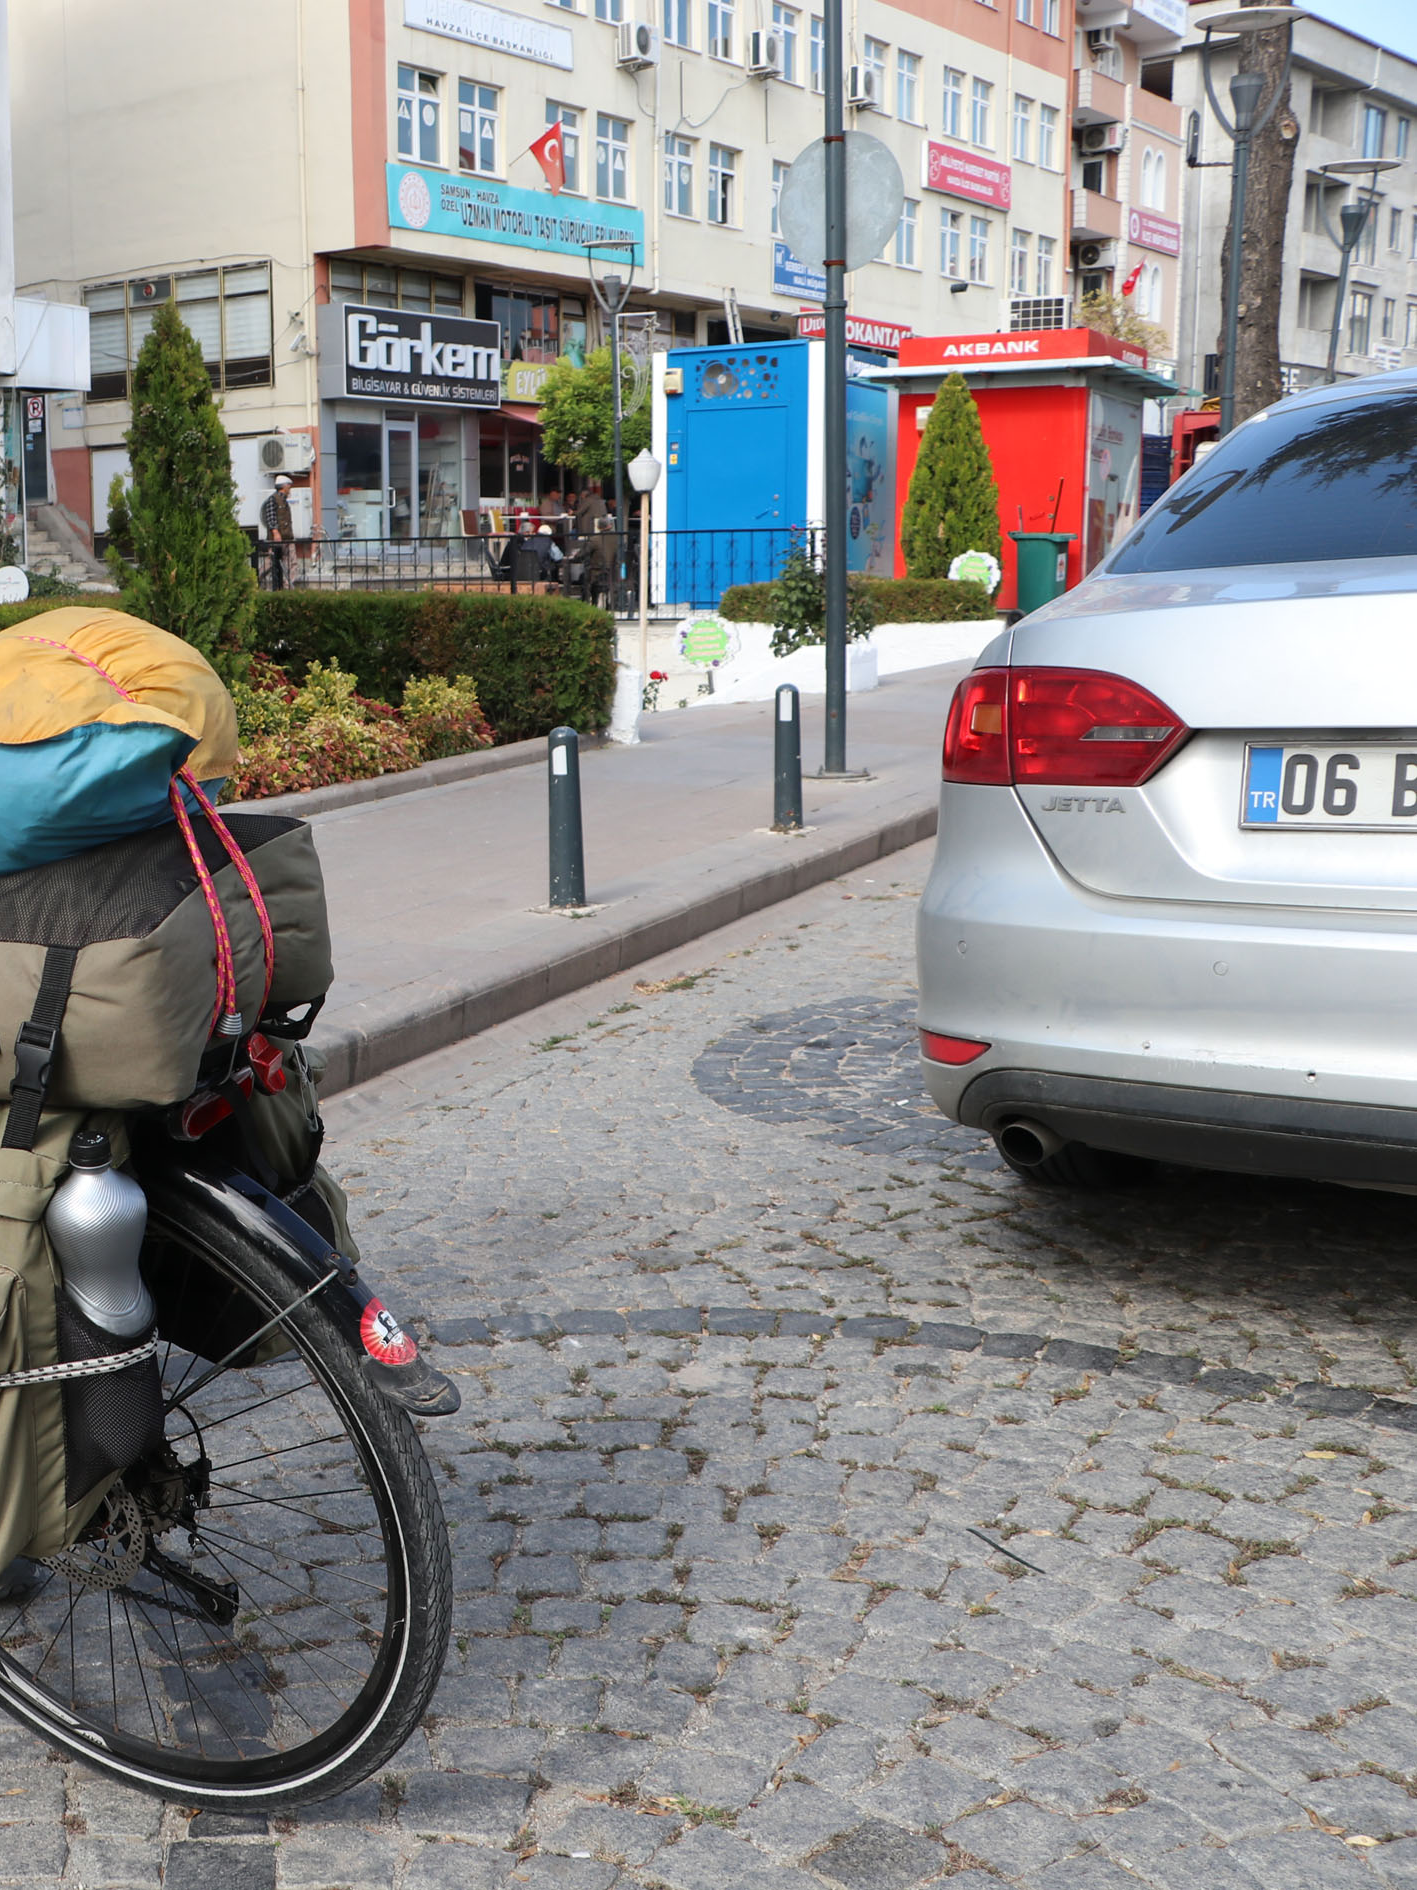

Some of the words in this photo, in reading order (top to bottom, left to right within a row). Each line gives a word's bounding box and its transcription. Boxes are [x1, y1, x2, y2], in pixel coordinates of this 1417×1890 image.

[426, 17, 462, 34] HAVZA
[465, 28, 489, 42] İLÇE
[440, 183, 471, 199] SAMSUN
[477, 190, 500, 204] HAVZA
[461, 202, 491, 229] UZMAN
[494, 207, 533, 236] MOTORLU
[535, 214, 557, 245] TAŞIT
[348, 313, 500, 381] Görkem
[845, 320, 912, 348] OKANTA
[943, 339, 1040, 357] AKBANK
[352, 375, 401, 393] BİLGİSAYAR
[403, 382, 410, 395] &
[411, 380, 451, 397] GÜVENLİK
[452, 384, 497, 401] SİSTEMLERİ
[515, 367, 546, 397] EYLÜ
[1250, 790, 1276, 809] TR
[1282, 753, 1361, 816] 06
[1041, 796, 1127, 814] JETTA
